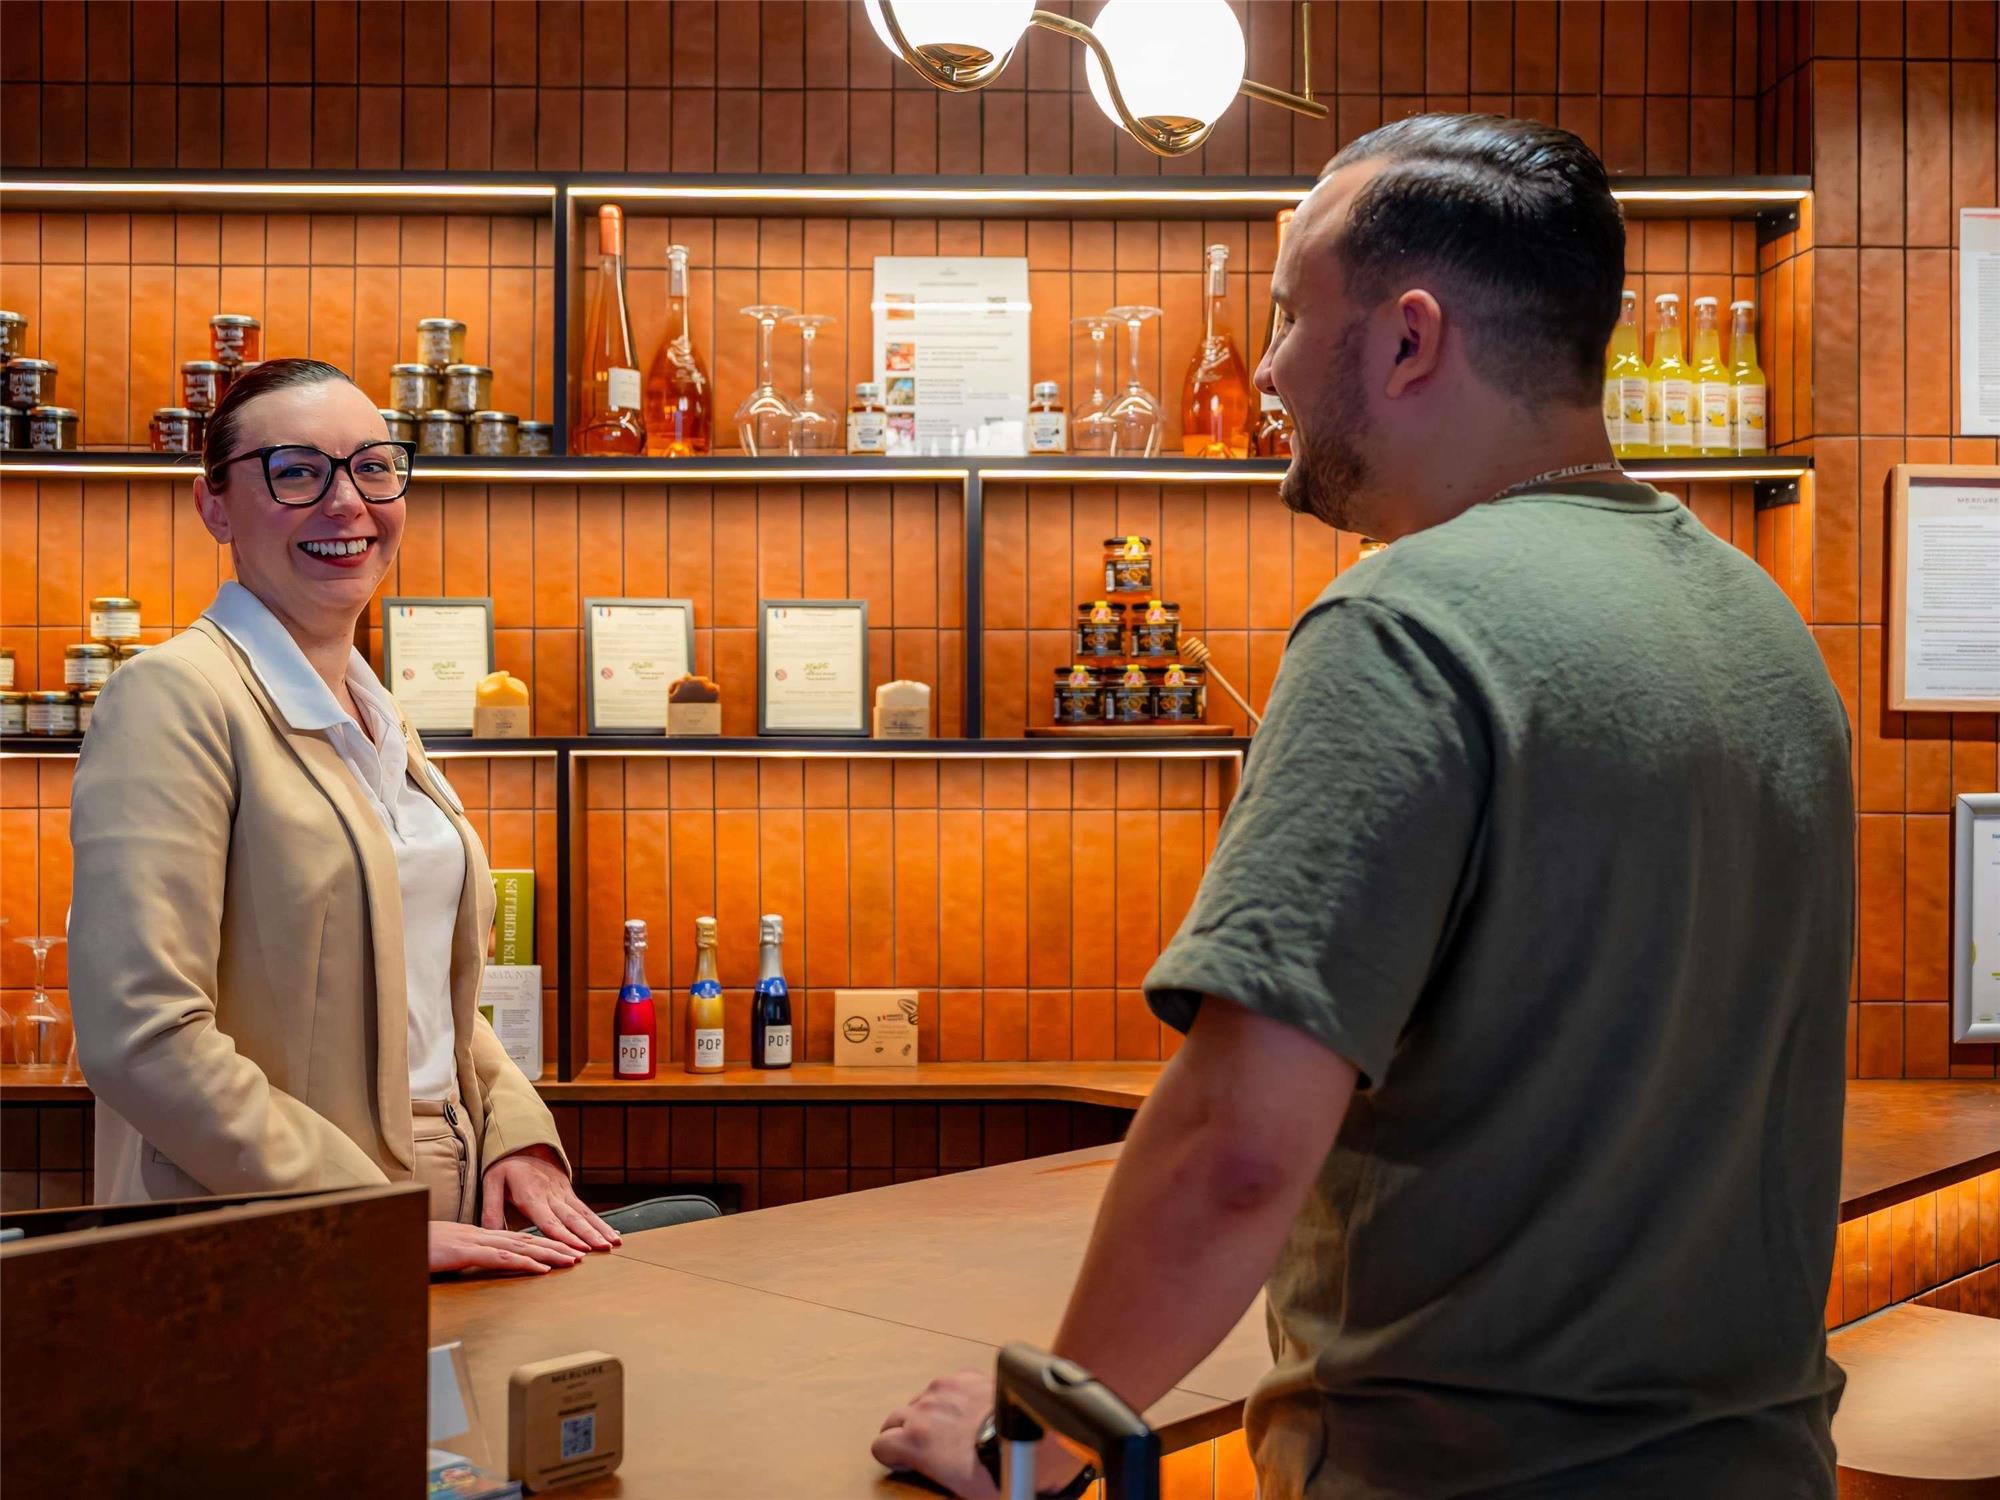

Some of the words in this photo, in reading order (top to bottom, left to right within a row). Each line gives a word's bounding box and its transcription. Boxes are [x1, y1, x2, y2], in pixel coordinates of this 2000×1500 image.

[697, 1038, 721, 1051] POP
[768, 1035, 790, 1047] POP
[621, 1047, 646, 1060] POP
[552, 1365, 603, 1383] MERCURE
